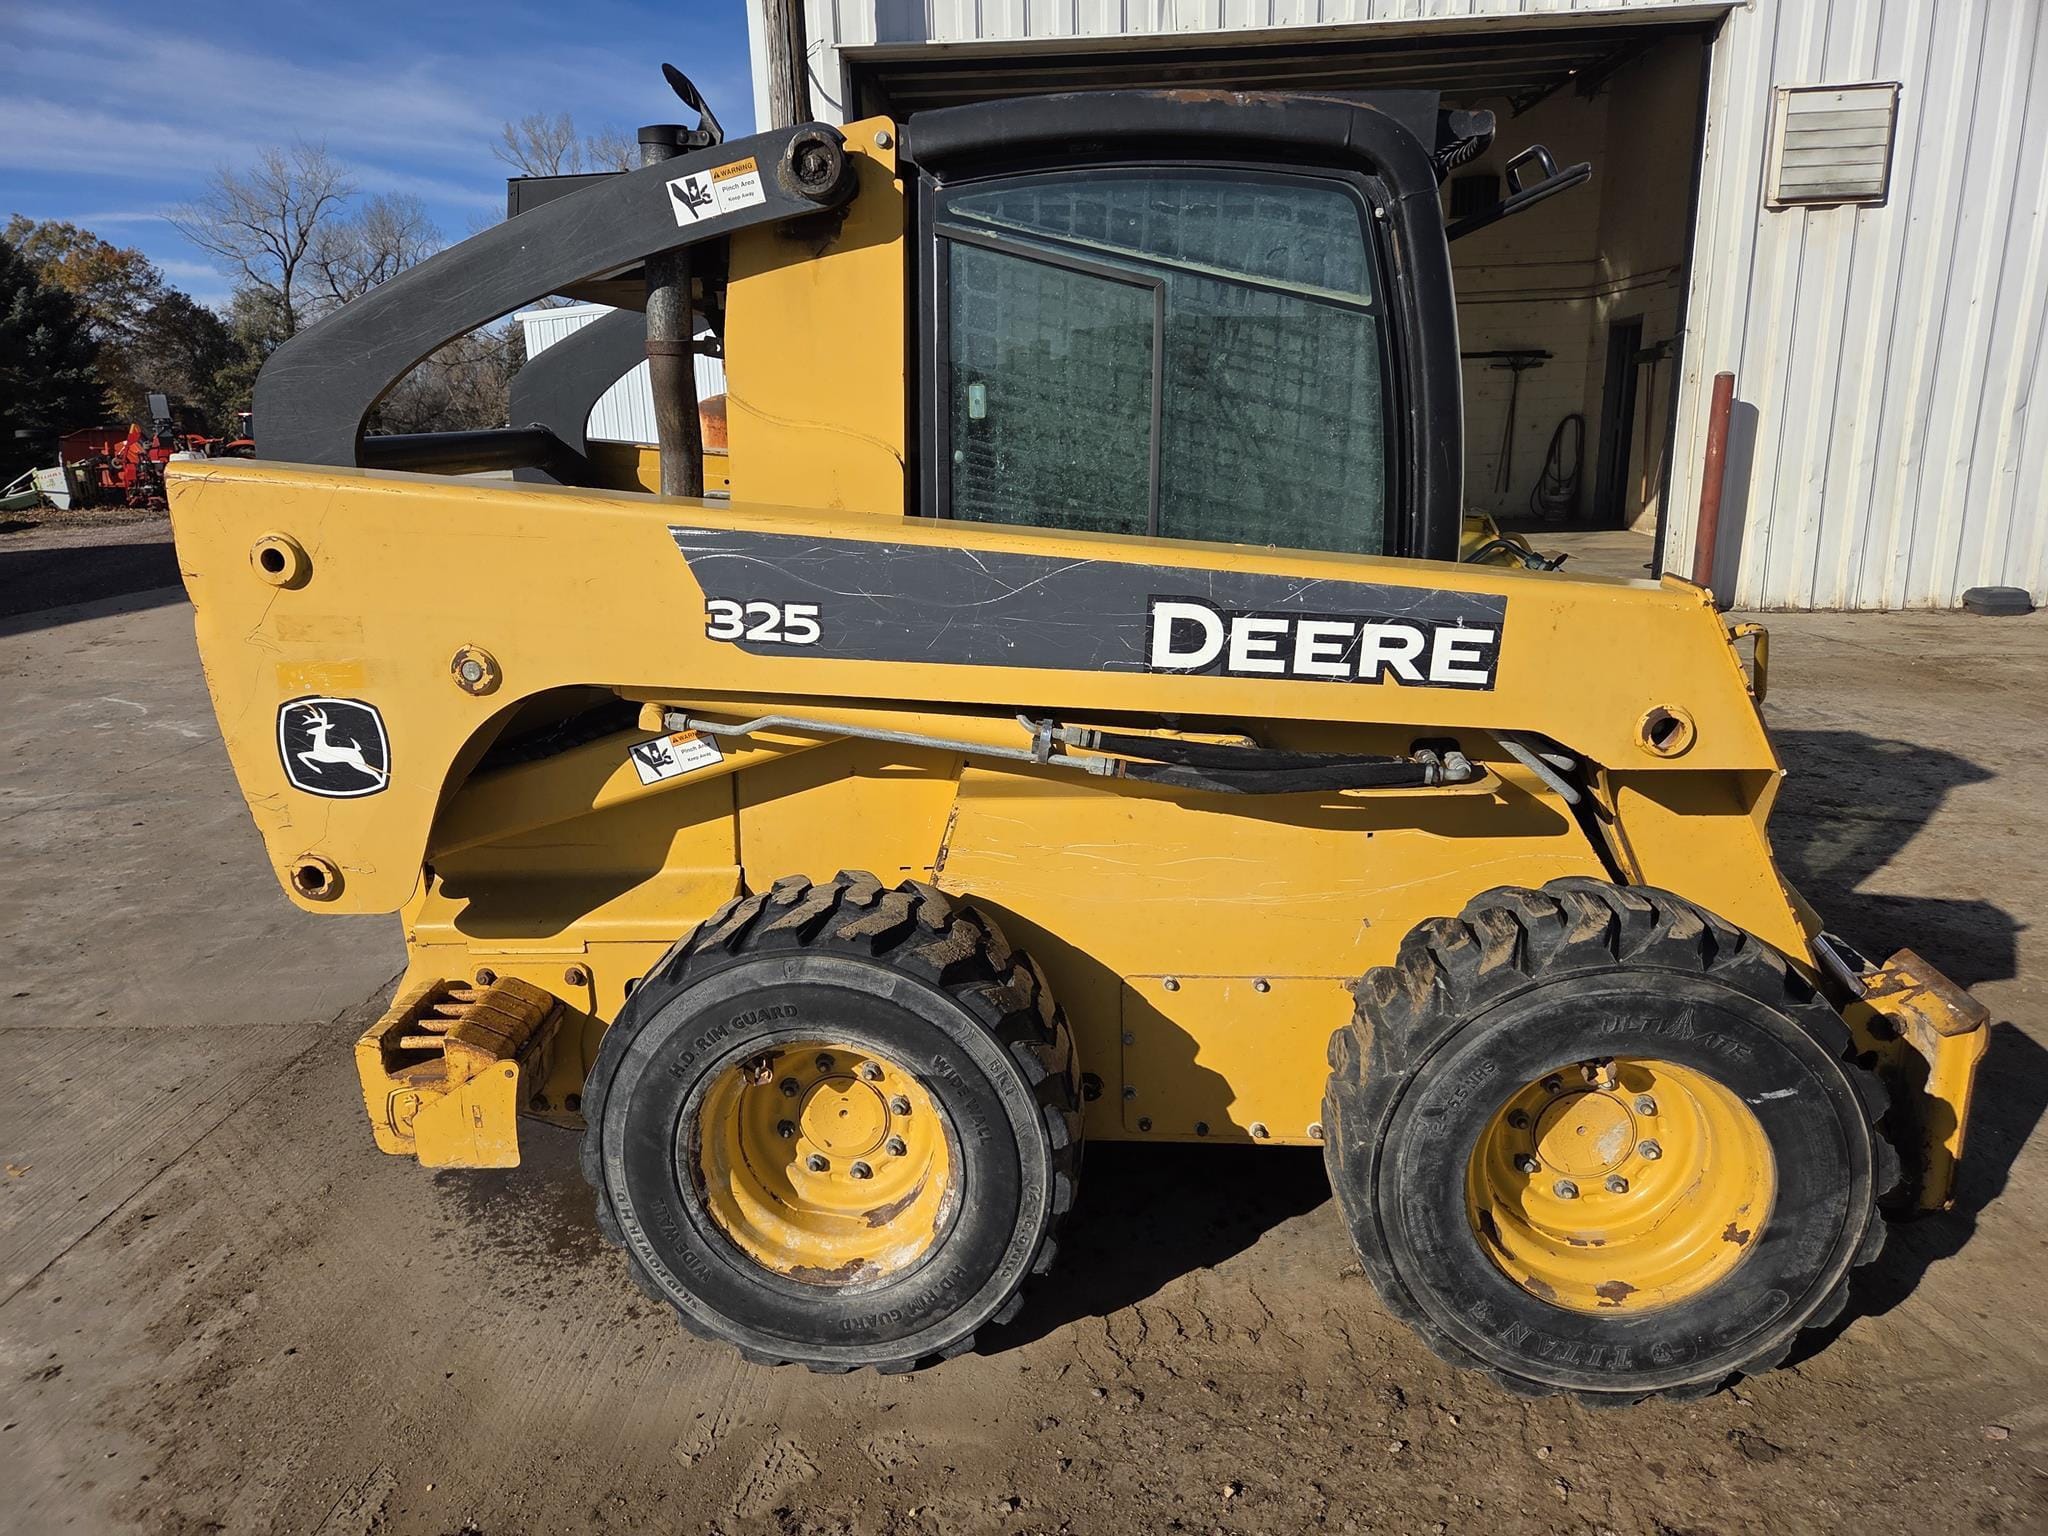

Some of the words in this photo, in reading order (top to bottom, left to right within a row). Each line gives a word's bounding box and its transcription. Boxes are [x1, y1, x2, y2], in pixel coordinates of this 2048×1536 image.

[720, 163, 753, 177] WARNING
[721, 183, 740, 193] Pinch
[740, 179, 755, 187] Area
[707, 599, 821, 644] 325
[1151, 602, 1495, 685] DEERE
[681, 746, 698, 754] Pinch
[700, 1024, 729, 1051] RIM
[731, 1004, 799, 1031] GUARD
[931, 1054, 970, 1098] WIDE
[987, 1059, 1017, 1097] BKT
[1464, 1057, 1497, 1090] NHS
[628, 1224, 668, 1277] POWER
[676, 1243, 713, 1284] WIDE
[840, 1310, 904, 1332] GUARD
[1500, 1319, 1634, 1371] TITAN
